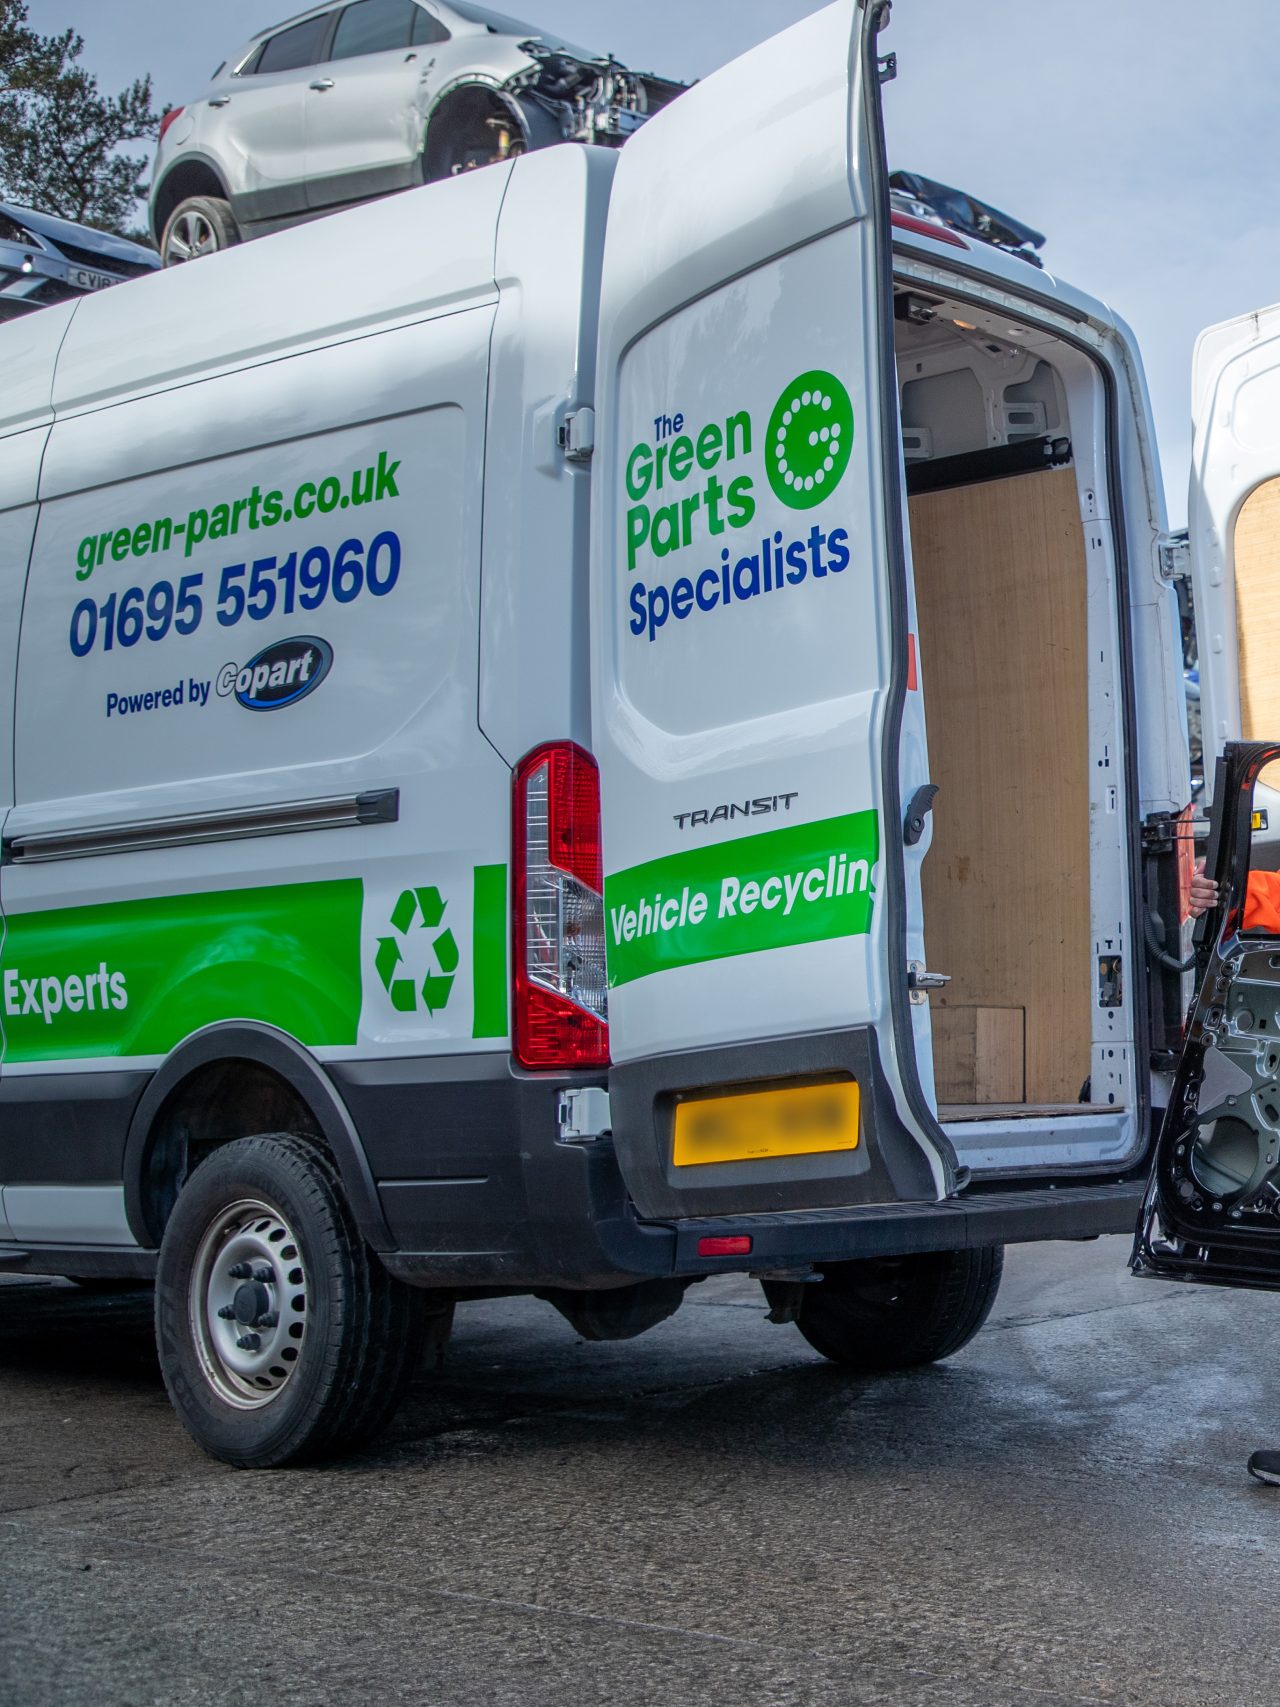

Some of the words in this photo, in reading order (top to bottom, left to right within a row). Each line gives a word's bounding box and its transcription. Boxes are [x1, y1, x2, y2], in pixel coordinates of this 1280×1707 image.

[625, 410, 752, 501] Green
[654, 412, 684, 442] The
[75, 451, 402, 581] green-parts.co.uk
[627, 475, 756, 571] Parts
[69, 572, 203, 657] 01695
[216, 530, 402, 627] 551960
[629, 525, 850, 642] Specialists
[106, 680, 184, 717] Powered
[188, 677, 210, 707] by
[216, 648, 314, 699] Copart
[673, 792, 798, 830] TRANSIT
[610, 886, 708, 946] Vehicle
[3, 962, 128, 1024] Experts
